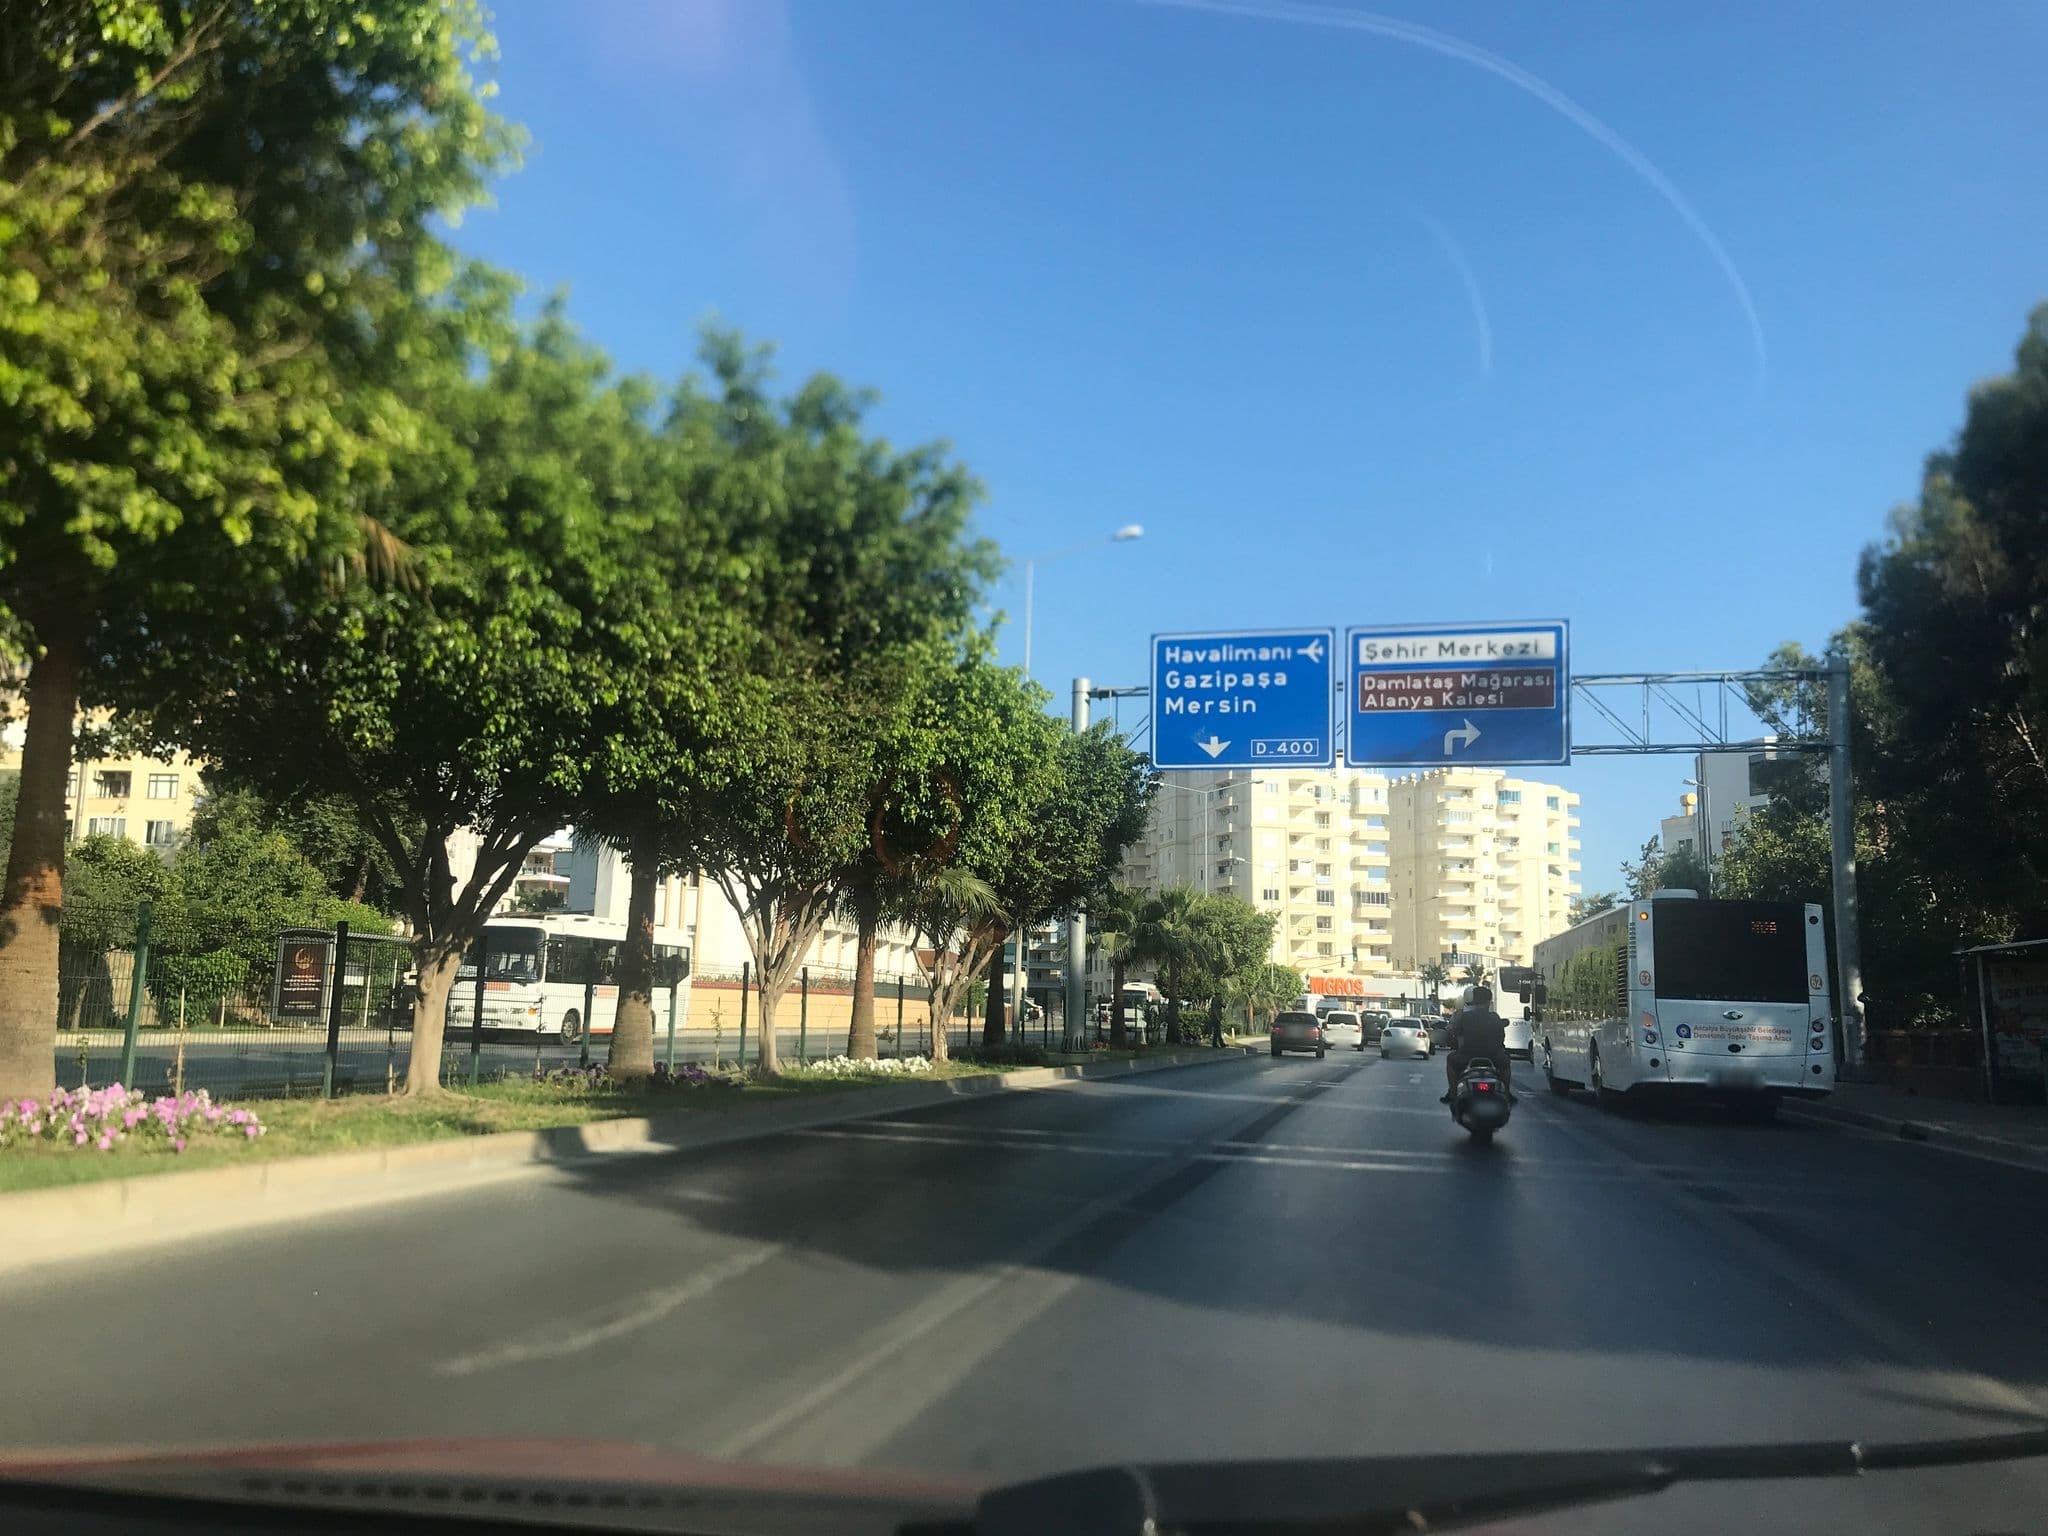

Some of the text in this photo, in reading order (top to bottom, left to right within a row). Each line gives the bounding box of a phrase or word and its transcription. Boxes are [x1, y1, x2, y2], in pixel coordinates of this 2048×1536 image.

[1165, 644, 1292, 664] Havalimanı
[1366, 639, 1539, 661] Şehir Merkezi
[1165, 670, 1287, 692] Gazipaşa
[1364, 673, 1550, 690] Damlataş Mağarası
[1165, 696, 1257, 715] Mersin
[1365, 691, 1504, 710] Alanya Kalesi
